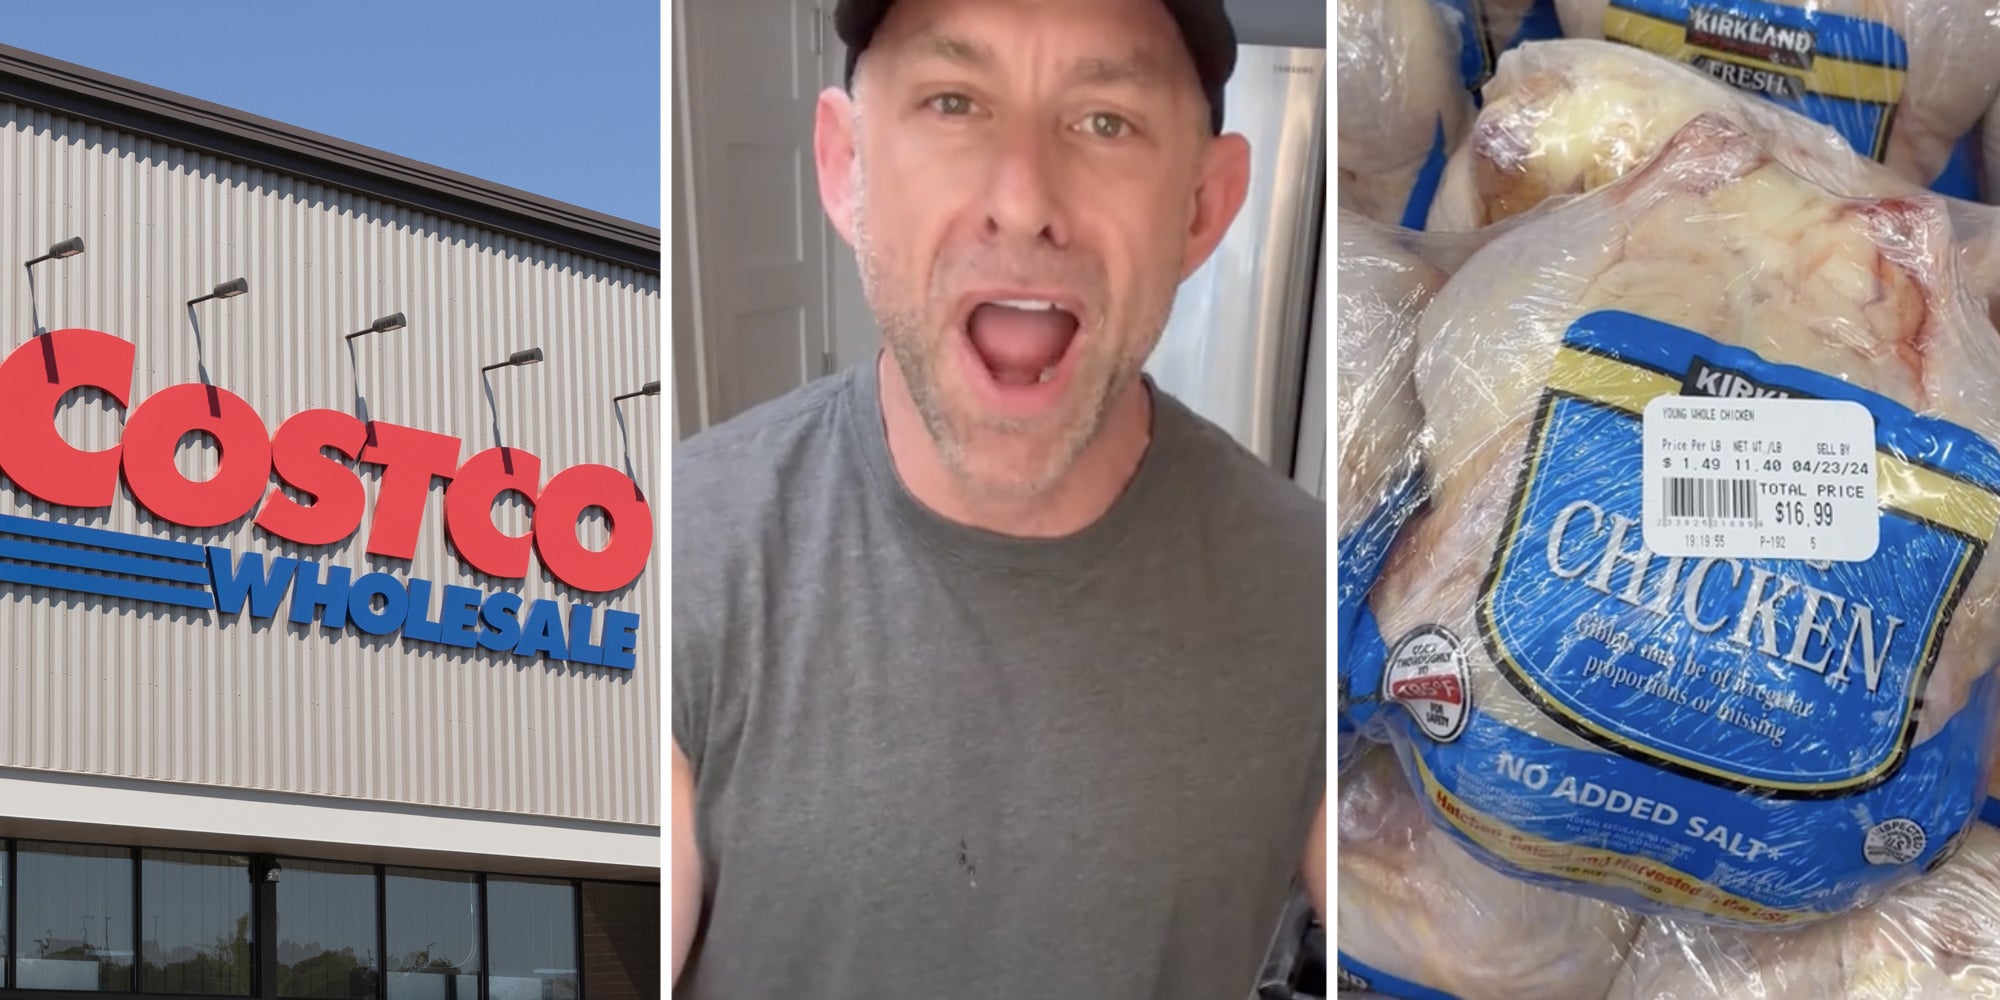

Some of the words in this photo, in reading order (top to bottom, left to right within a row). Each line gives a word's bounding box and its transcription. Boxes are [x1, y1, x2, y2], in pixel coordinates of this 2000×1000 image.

[1694, 9, 1812, 54] KIRKLAND
[1662, 407, 1687, 420] YOUNG
[1691, 408, 1716, 421] WHOLE
[1720, 408, 1755, 422] CHICKEN
[1662, 438, 1687, 451] Price
[1691, 439, 1706, 451] Per
[1710, 440, 1722, 452] LB
[1733, 440, 1748, 452] NET
[1816, 443, 1836, 456] SELL
[1840, 443, 1851, 456] BY
[0, 328, 653, 592] COSTCO
[1662, 457, 1672, 469] $
[1683, 457, 1721, 471] 1.49
[1735, 458, 1782, 472] 11.40
[1792, 460, 1869, 475] 04/23/24
[1759, 482, 1807, 496] TOTAL
[1817, 485, 1865, 499] PRICE
[1775, 501, 1833, 527] $16.99
[1685, 534, 1725, 548] 19:19:55
[1760, 536, 1786, 549] P-192
[1810, 537, 1817, 549] 5
[1547, 500, 1903, 693] CHICKEN
[205, 546, 640, 670] WHOLESALE
[1685, 652, 1707, 678] be
[1710, 667, 1734, 693] of
[1583, 654, 1689, 706] proportions
[1692, 694, 1713, 714] or
[1716, 702, 1788, 748] missing
[1497, 751, 1550, 790] NO
[1551, 776, 1679, 826] ADDED
[1616, 857, 1701, 896] Harvested
